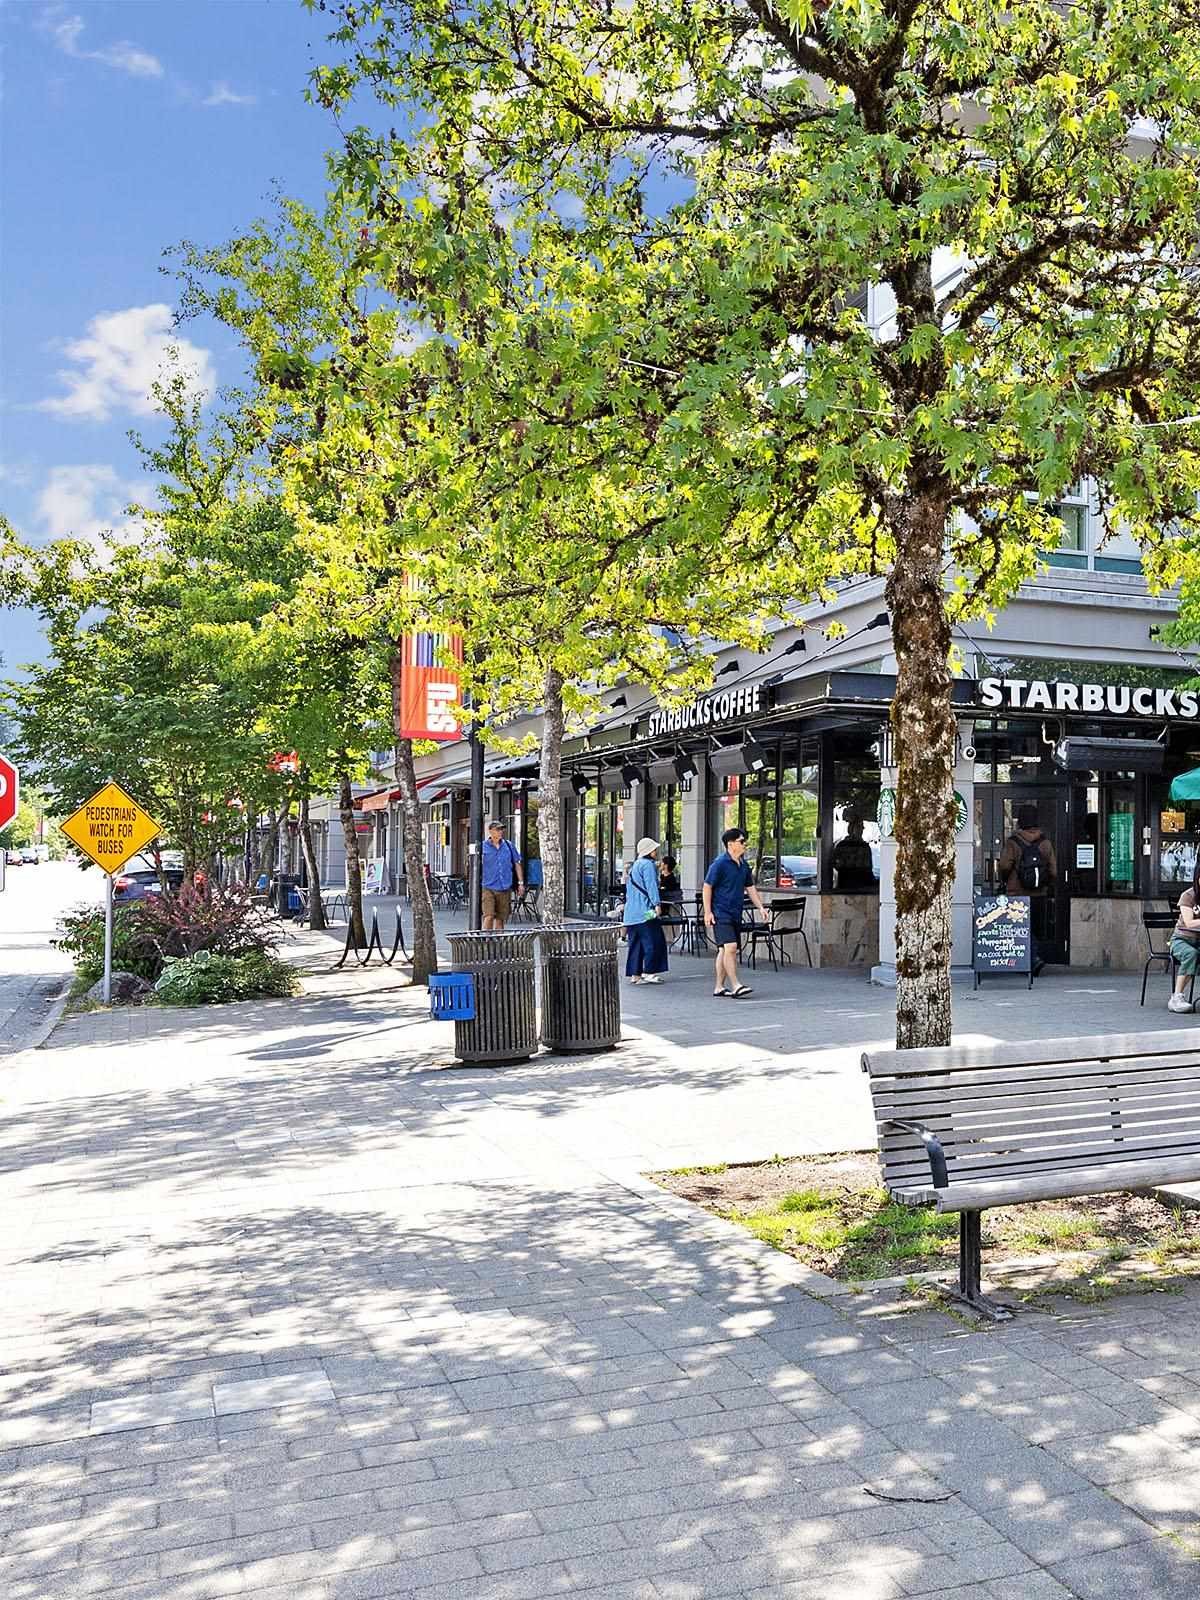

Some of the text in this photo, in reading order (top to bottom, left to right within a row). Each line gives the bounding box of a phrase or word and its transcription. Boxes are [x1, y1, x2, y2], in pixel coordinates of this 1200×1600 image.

[426, 682, 458, 733] SFU
[648, 684, 760, 737] STARBUCKS COFFEE
[981, 677, 1199, 718] STARBUCKS
[86, 807, 136, 821] PEDESTRIANS
[89, 824, 132, 837] WATCH FOR
[97, 840, 124, 854] BUSES
